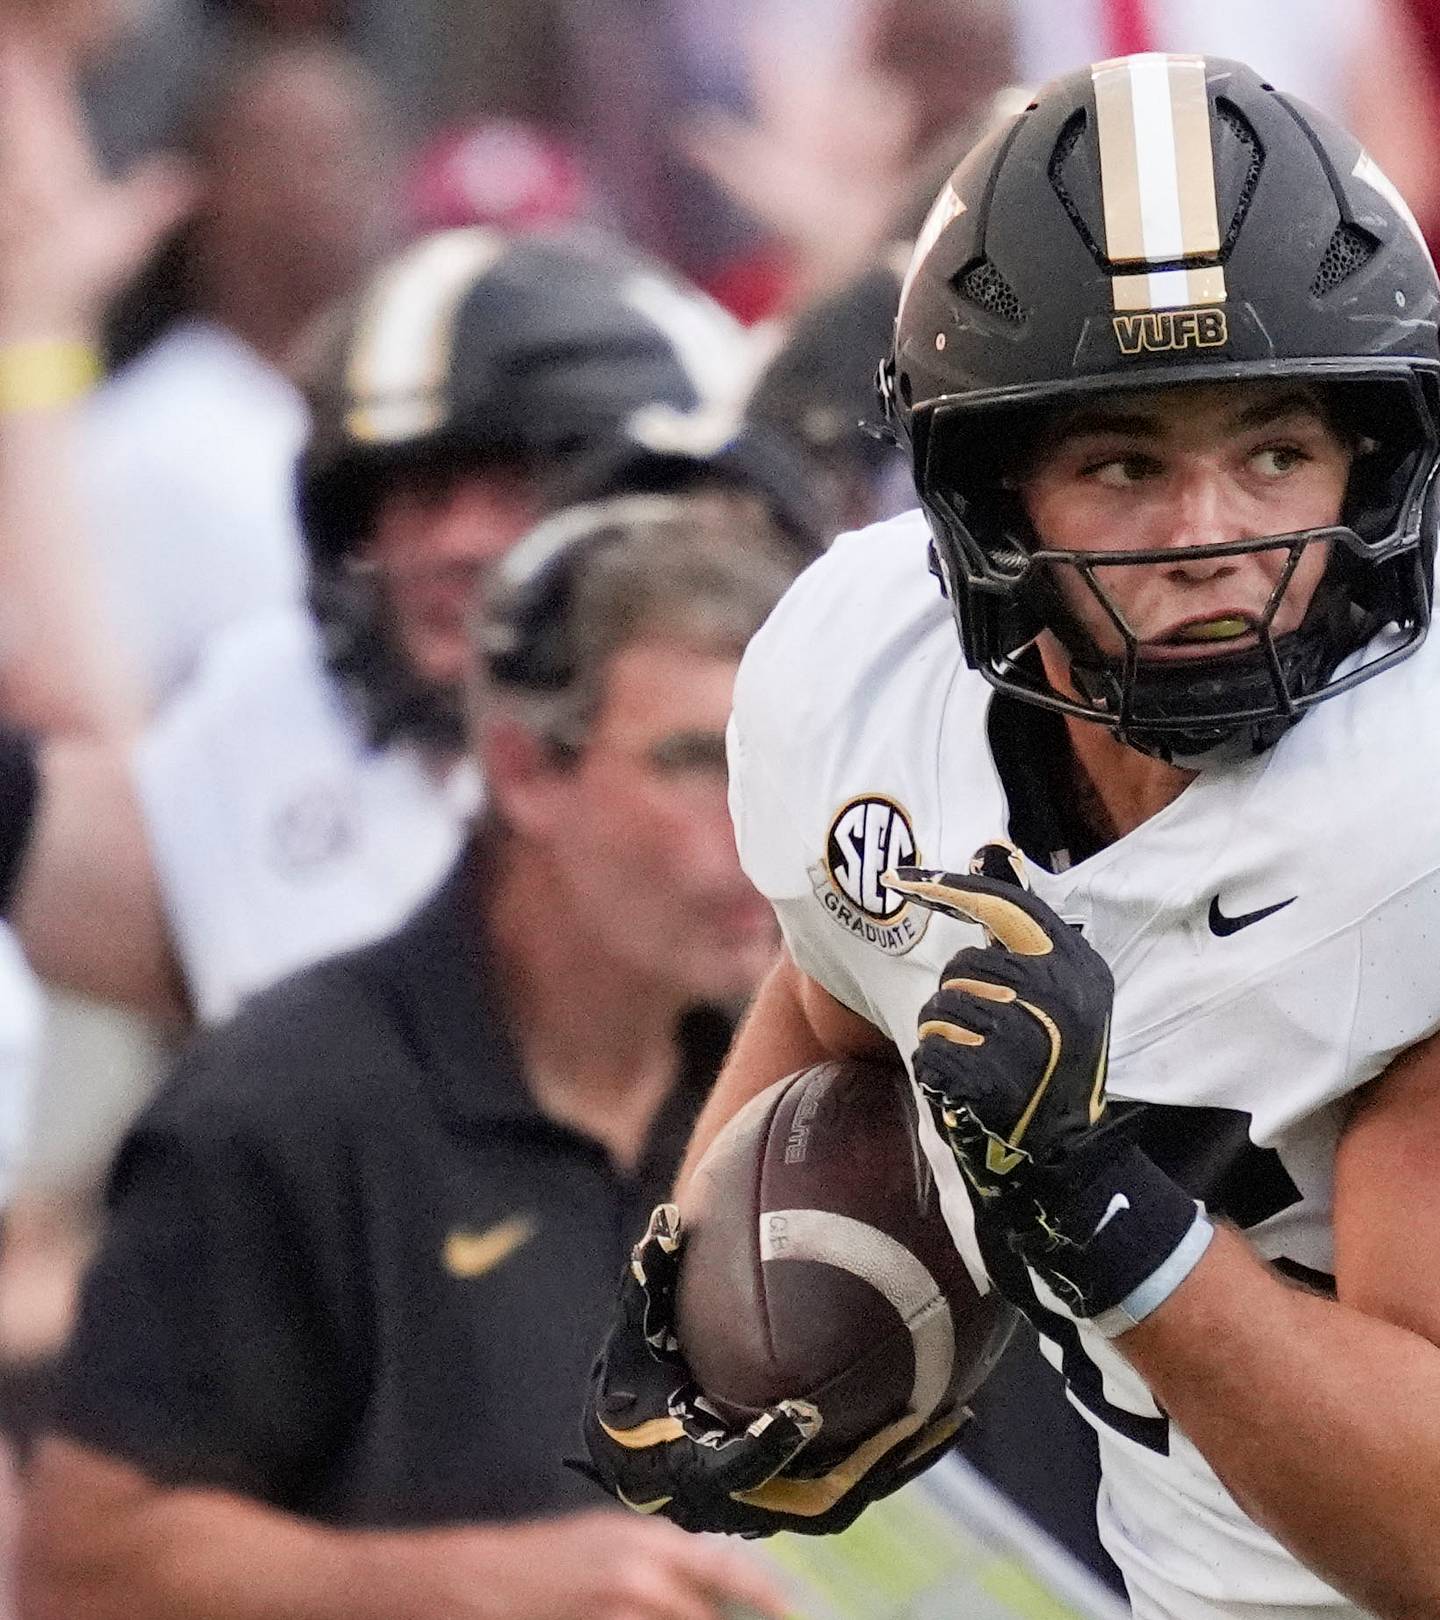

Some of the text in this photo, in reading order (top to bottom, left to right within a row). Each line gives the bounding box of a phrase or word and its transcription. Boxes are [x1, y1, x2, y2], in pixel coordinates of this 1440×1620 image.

[1112, 308, 1228, 354] VUFB
[834, 802, 916, 915] SEC
[824, 892, 917, 949] GRADUATE
